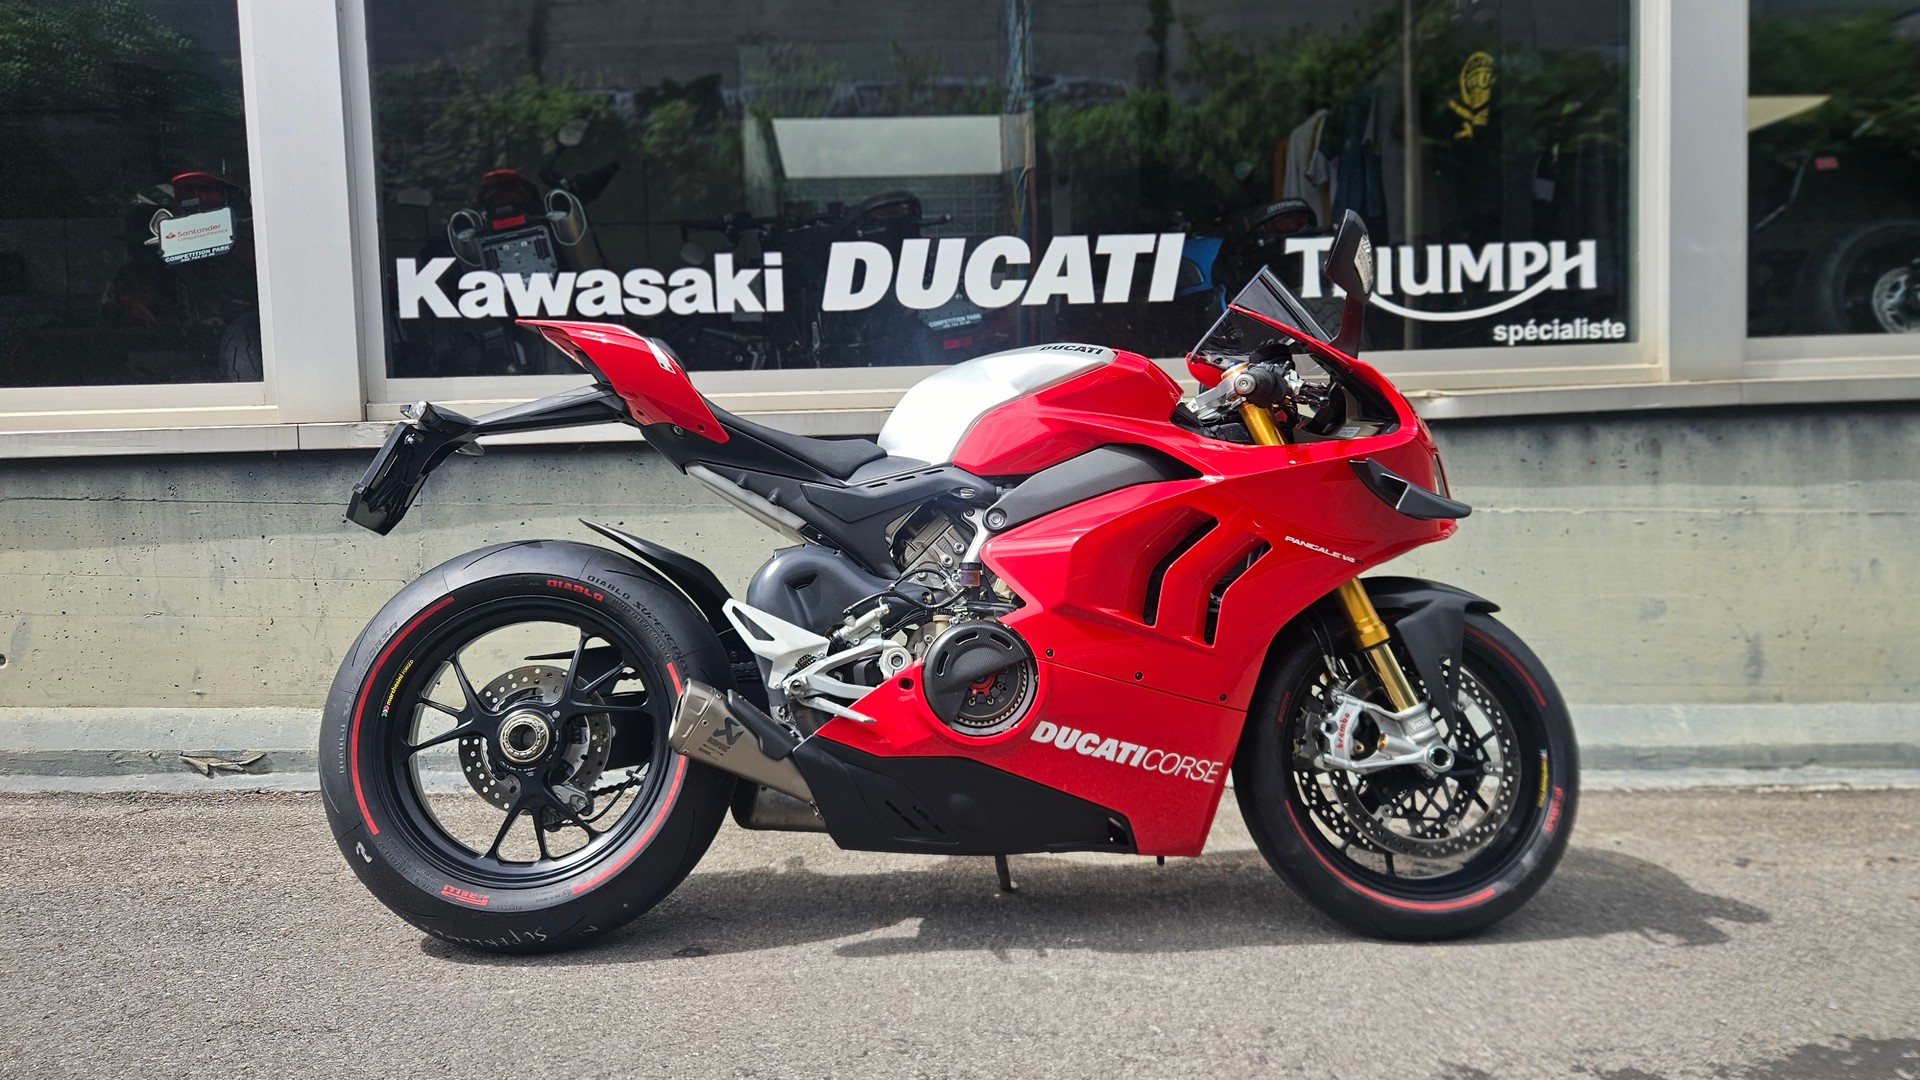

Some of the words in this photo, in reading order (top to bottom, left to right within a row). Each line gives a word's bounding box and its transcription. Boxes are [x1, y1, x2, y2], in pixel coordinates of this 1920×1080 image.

[177, 224, 222, 238] Santander
[165, 249, 211, 263] COMPETITION
[211, 245, 230, 254] PARK
[822, 232, 1186, 311] DUCATI
[1284, 237, 1597, 321] TIUMPH
[396, 251, 784, 319] Kawasaki
[1493, 318, 1626, 345] spécialiste
[1039, 345, 1104, 355] DUCATI
[1284, 535, 1341, 559] PANIGALE
[546, 579, 604, 602] DIABLO
[587, 574, 631, 600] DIABLO
[386, 673, 404, 706] marchesini
[1336, 712, 1350, 749] brembo
[441, 884, 490, 906] PIRELLI
